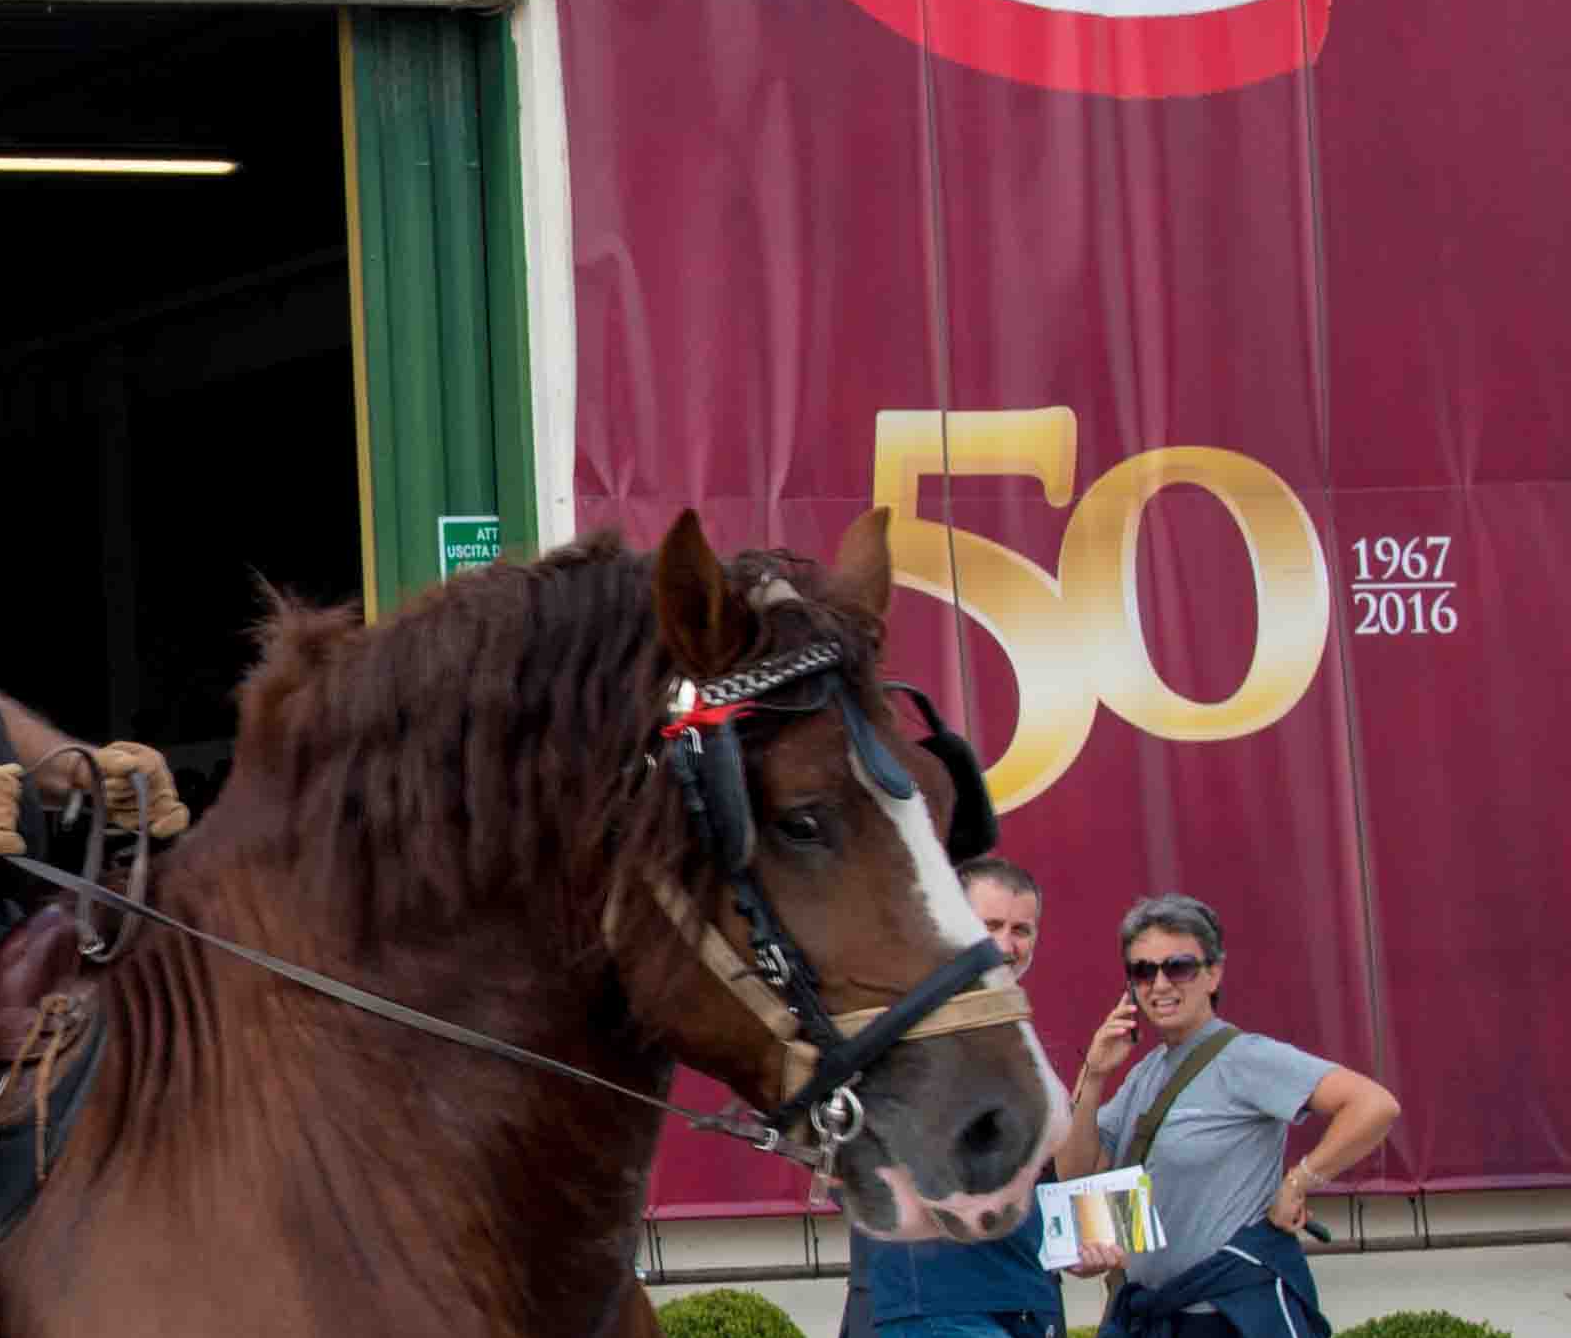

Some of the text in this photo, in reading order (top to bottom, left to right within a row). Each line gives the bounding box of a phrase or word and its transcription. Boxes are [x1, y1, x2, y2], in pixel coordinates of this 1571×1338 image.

[447, 544, 490, 558] USCITA
[477, 527, 499, 541] ATT
[1352, 536, 1452, 580] 1967
[872, 406, 1330, 816] 50
[1353, 591, 1459, 636] 2016
